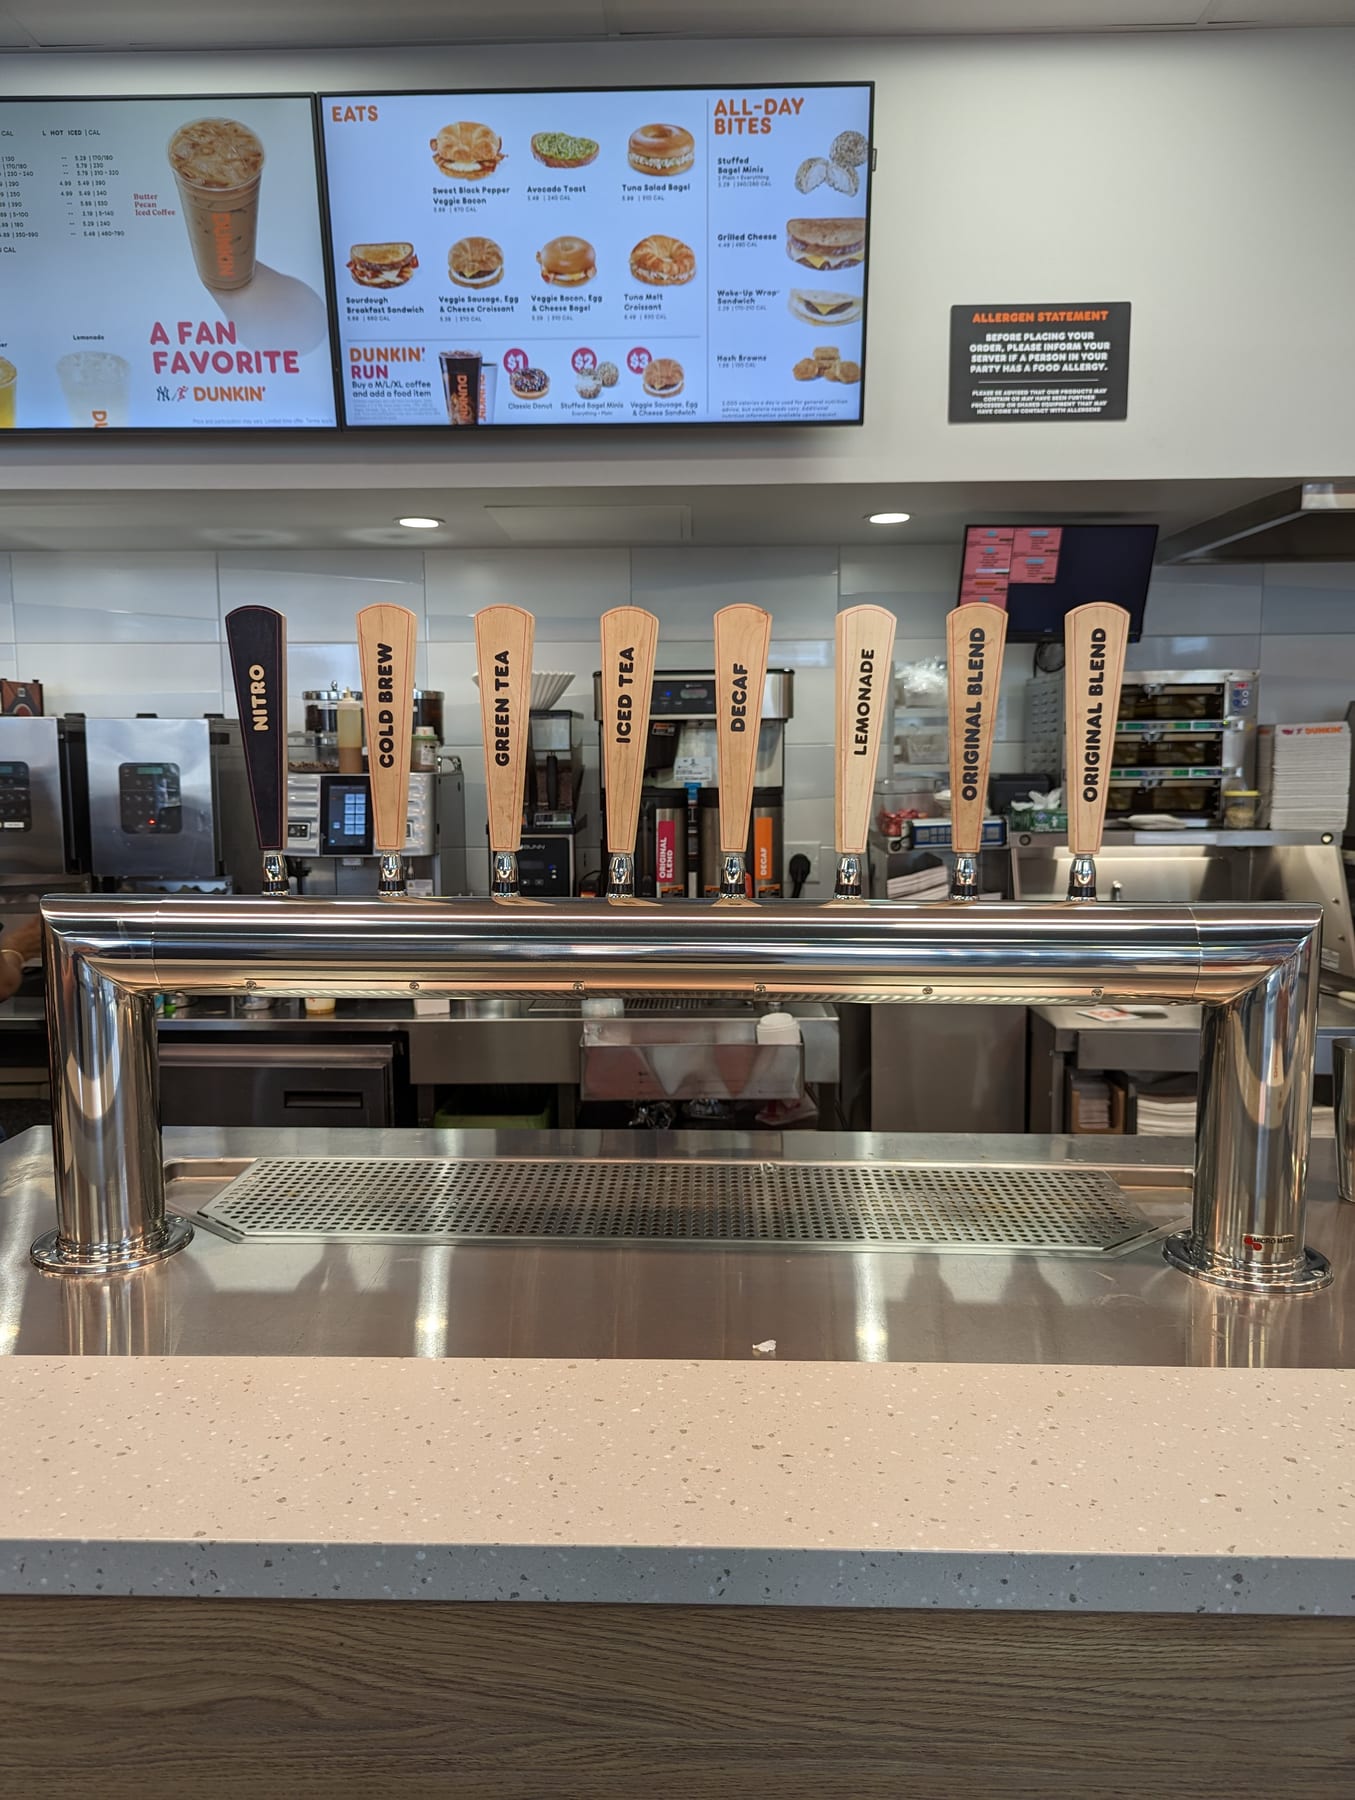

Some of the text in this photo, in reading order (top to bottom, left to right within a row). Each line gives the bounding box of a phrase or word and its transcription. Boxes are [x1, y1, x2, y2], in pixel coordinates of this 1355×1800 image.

[714, 98, 805, 116] ALL-DAY
[332, 105, 379, 122] EATS
[714, 117, 772, 135] BITES
[717, 157, 750, 165] Stuffed
[717, 166, 741, 175] Bagel
[433, 187, 457, 195] Sweet
[482, 186, 510, 195] Pepper
[527, 185, 586, 193] Avocado Toast
[622, 184, 642, 192] Tuna
[668, 183, 691, 193] Bagel
[133, 193, 158, 201] Butter
[433, 197, 487, 206] Veggie Bacon
[152, 208, 176, 216] Coffee
[717, 233, 745, 241] Grilled
[531, 295, 558, 303] Veggie
[588, 294, 603, 303] Egg
[717, 289, 753, 297] Wake-Up
[346, 297, 388, 305] Sourdough
[439, 296, 465, 304] Veggie
[504, 295, 519, 304] Egg
[346, 306, 425, 314] Breakfast Sandwich
[476, 305, 514, 313] Croissant
[569, 304, 591, 313] Bagel
[972, 310, 1109, 324] ALLERGEN STATEMENT
[150, 321, 236, 345] A FAN
[986, 331, 1095, 342] BEFORE PLACING YOUR
[969, 342, 1111, 353] ORDER, PLEASE INFORM YOUR
[350, 347, 426, 363] DUNKIN'
[971, 352, 1108, 363] SERVER IF A PERSON IN YOUR
[153, 351, 300, 374] FAVORITE
[508, 354, 525, 371] $1
[576, 353, 593, 370] $2
[630, 353, 648, 370] $3
[351, 365, 389, 379] RUN
[970, 363, 1108, 374] PARTY HAS A FOOD ALLERGY.
[352, 381, 366, 390] Buy
[375, 381, 403, 389] M/L/XL
[193, 386, 266, 402] DUNKIN'
[352, 390, 367, 398] and
[369, 390, 385, 398] add
[393, 389, 412, 397] food
[413, 389, 431, 397] item
[588, 402, 605, 410] Bagel
[630, 402, 653, 410] Veggie
[686, 401, 698, 409] Egg
[248, 664, 270, 732] NITRO
[616, 647, 635, 744] ICED TEA
[730, 663, 748, 732] DECAF
[377, 642, 395, 768] COLD BREW
[853, 648, 875, 756] LEMONADE
[494, 650, 510, 767] GREEN TEA
[962, 627, 986, 801] ORIGINAL BLEND
[1083, 628, 1107, 803] ORIGINAL BLEND
[659, 837, 674, 879] ORIGINAL BLEND
[760, 847, 769, 876] DECAF
